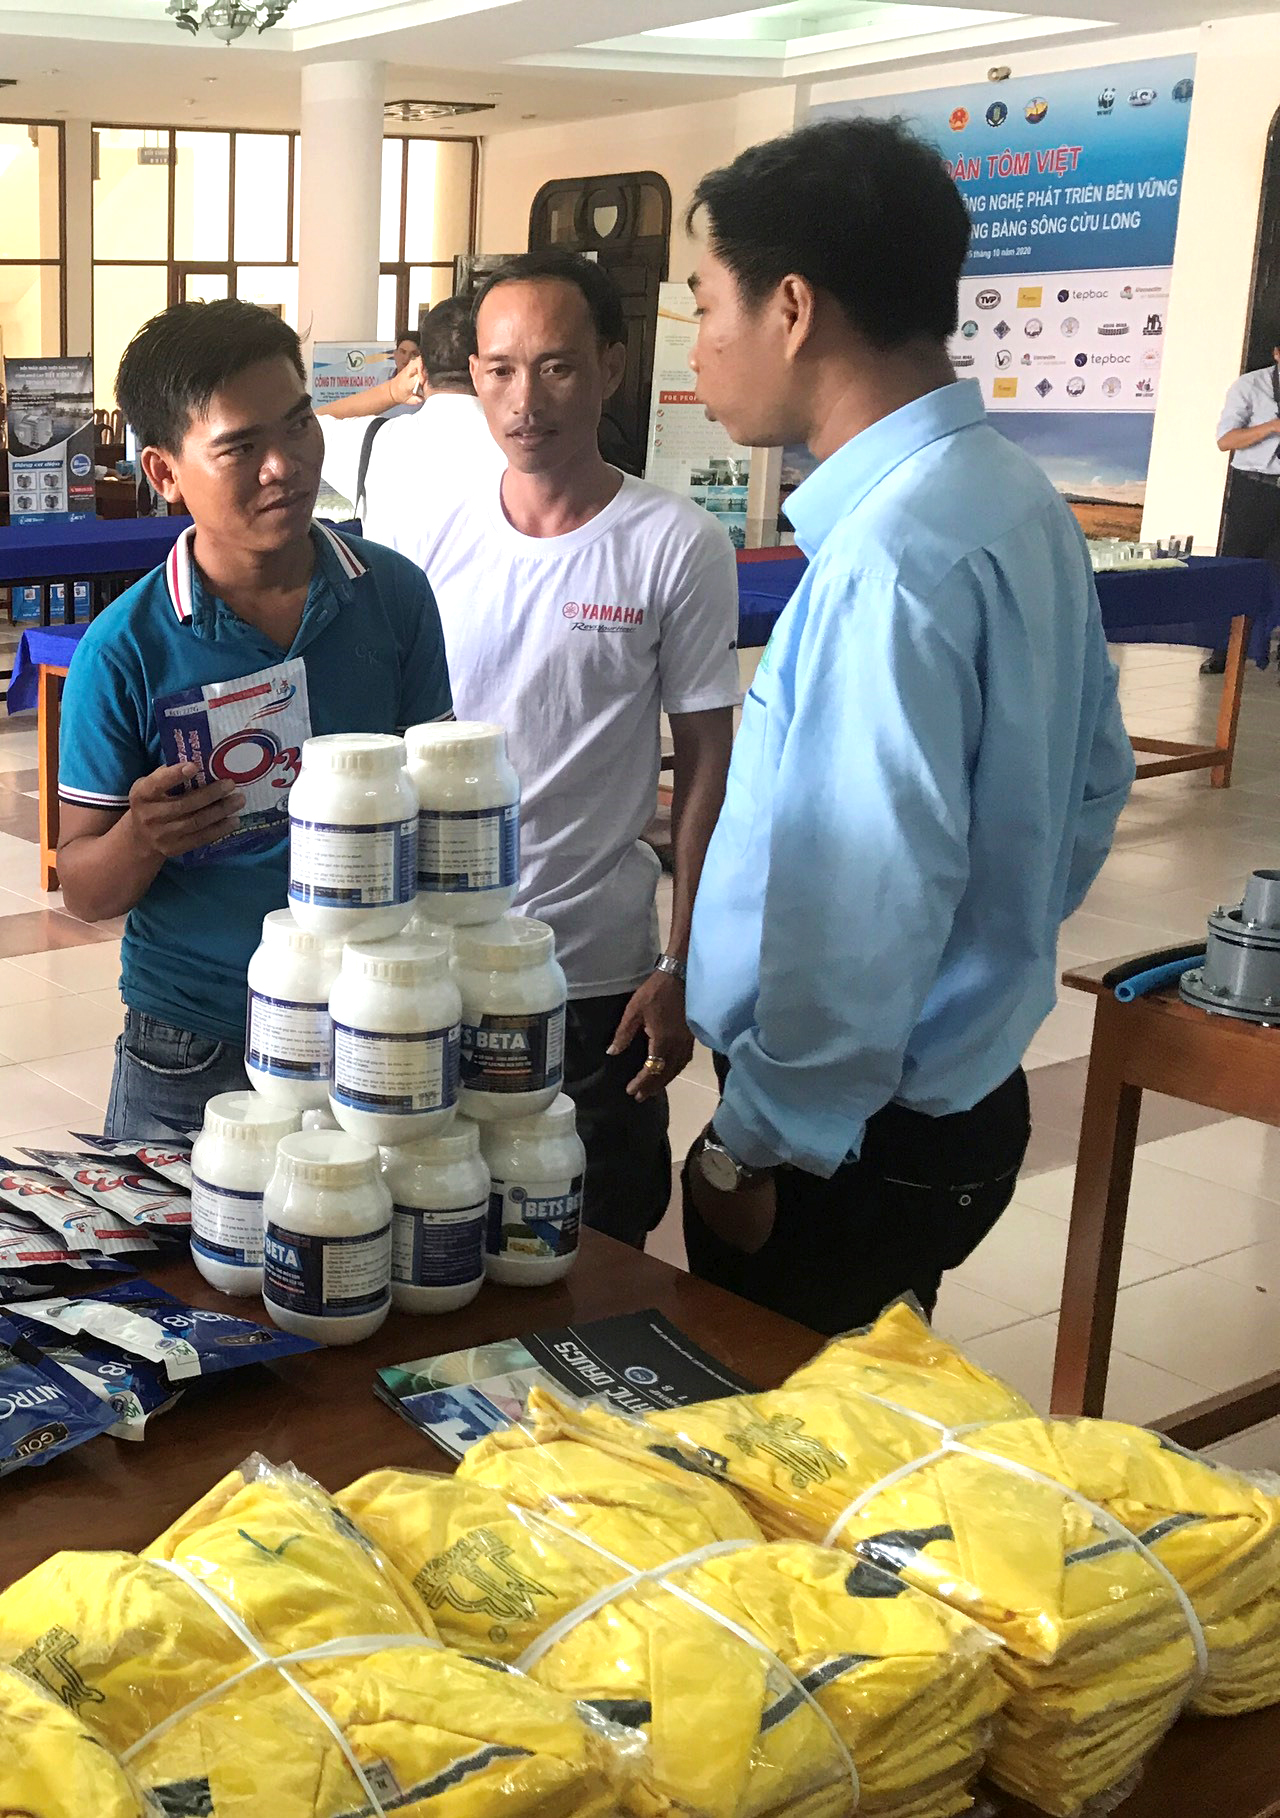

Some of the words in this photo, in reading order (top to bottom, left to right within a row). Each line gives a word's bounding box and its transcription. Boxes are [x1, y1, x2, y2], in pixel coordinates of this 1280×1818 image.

[987, 148, 1030, 179] TÔM
[1036, 144, 1083, 179] VIỆT
[963, 193, 986, 213] ÔNG
[989, 189, 1026, 213] NGHỆ
[1027, 185, 1060, 208] PHÁT
[970, 223, 989, 240] NG
[1030, 213, 1067, 235] SÔNG
[1070, 210, 1100, 233] CỬU
[1102, 210, 1141, 231] LONG
[1016, 246, 1031, 256] 2020
[1072, 289, 1109, 300] tepbac
[1091, 353, 1131, 365] tepbac
[582, 603, 644, 625] YAMAHA
[476, 1030, 526, 1050] BETA
[525, 1199, 564, 1217] BETS
[265, 1236, 298, 1268] BETA
[97, 1360, 132, 1377] 18
[553, 1341, 616, 1388] DRUGS
